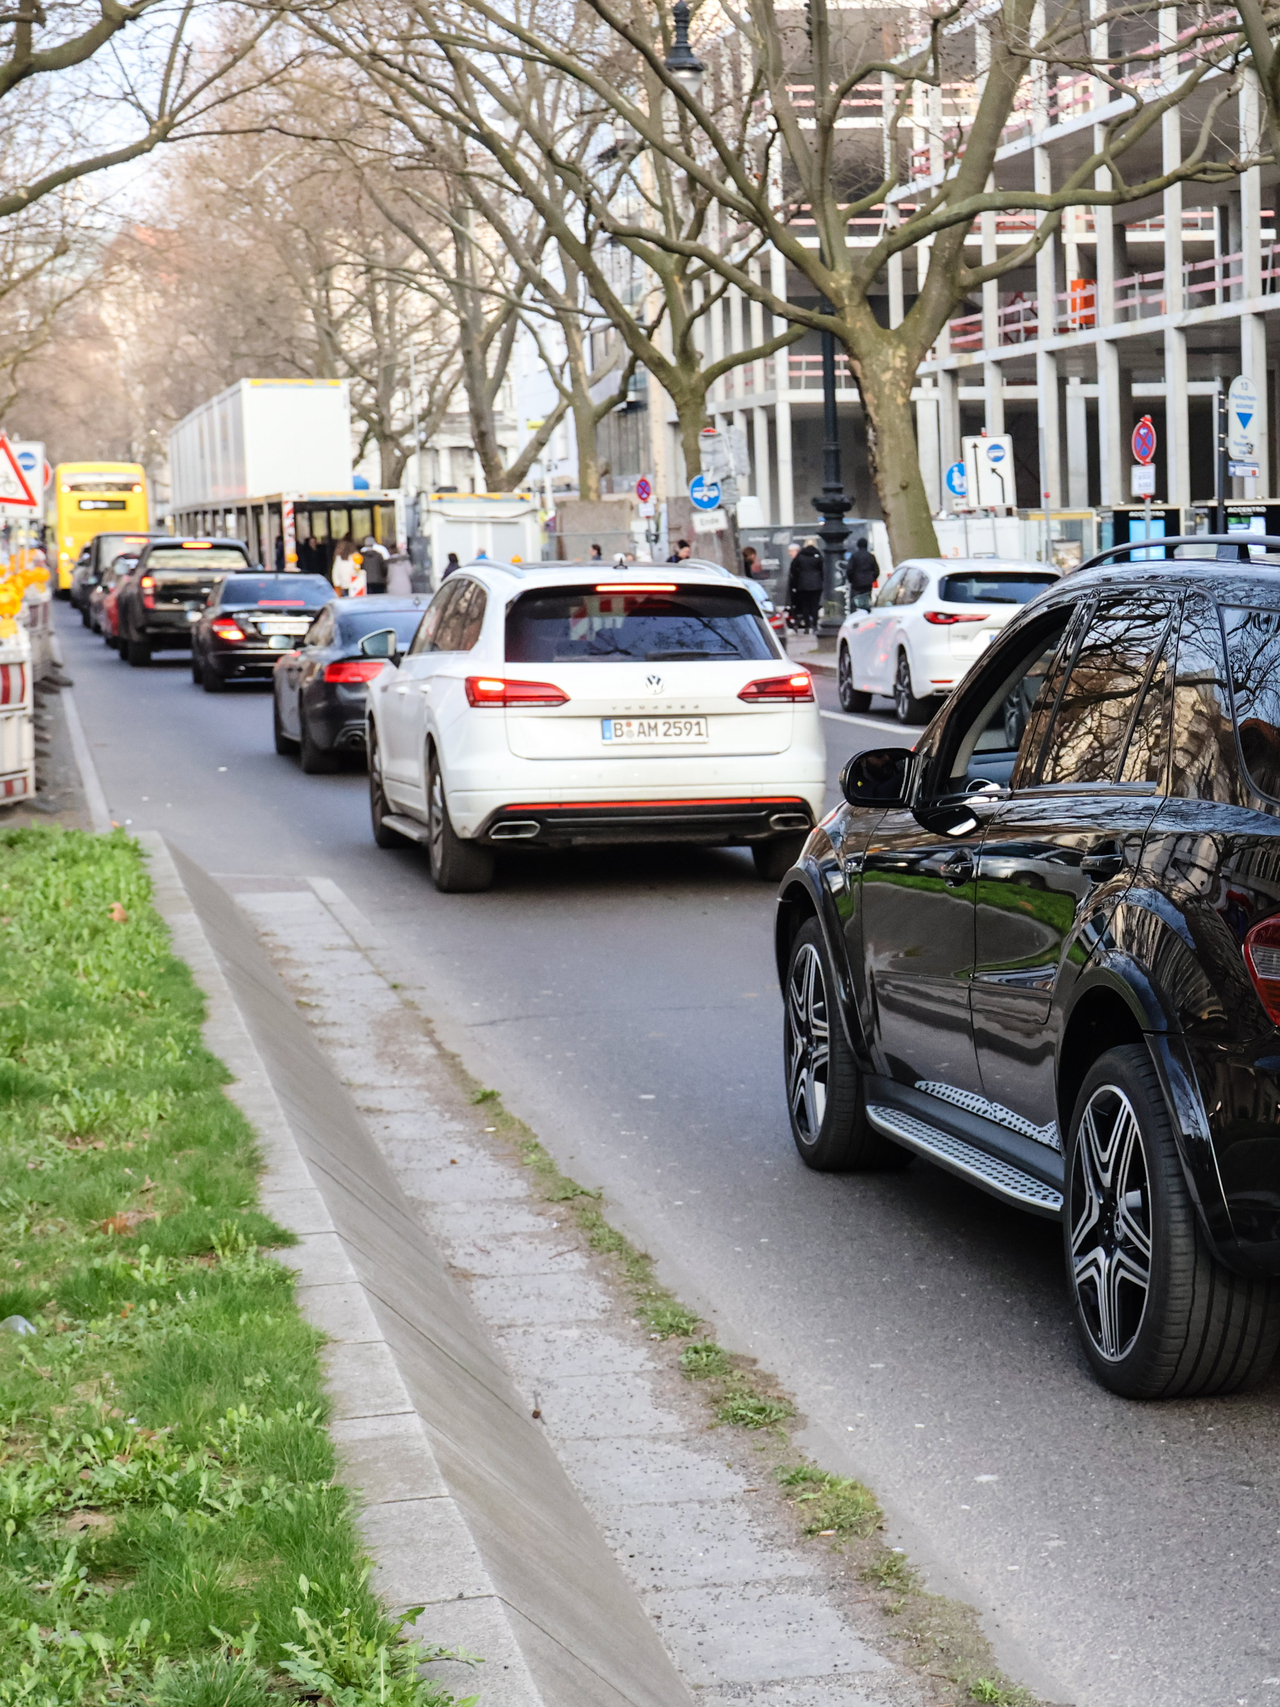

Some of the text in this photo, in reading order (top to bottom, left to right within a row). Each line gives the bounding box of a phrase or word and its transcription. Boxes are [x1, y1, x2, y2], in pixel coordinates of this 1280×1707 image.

[613, 720, 705, 738] B AM 2591
